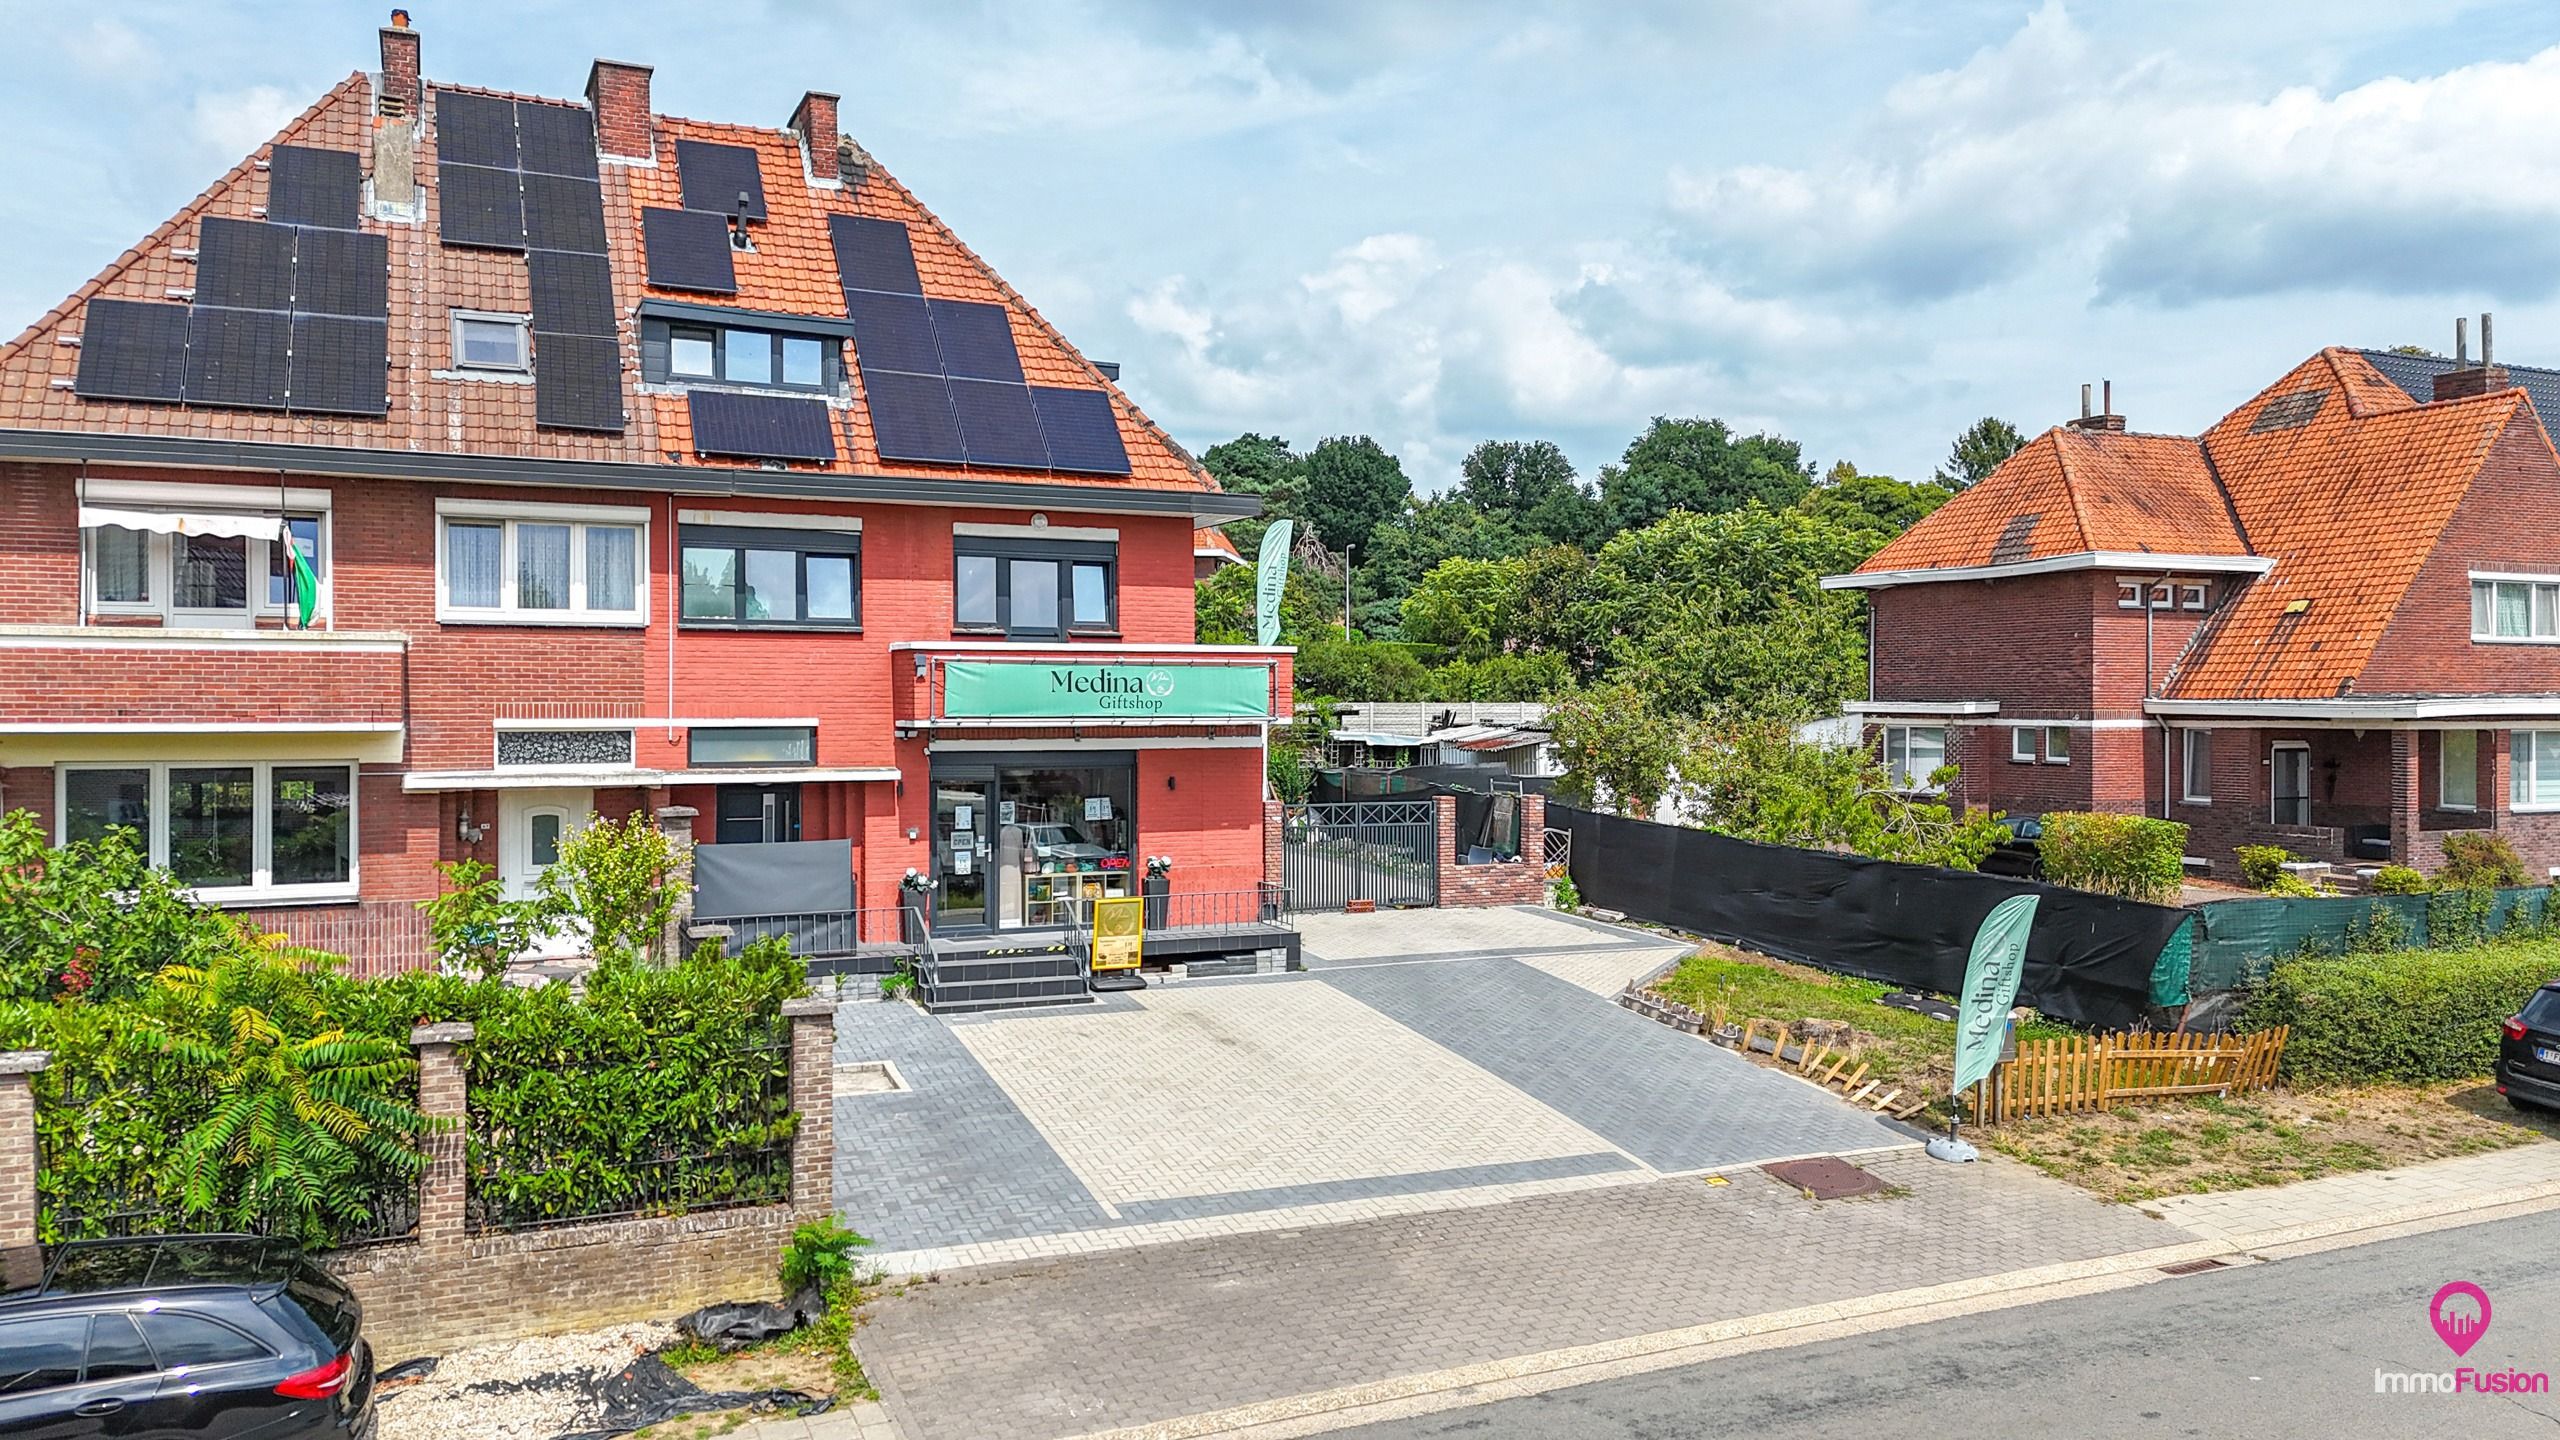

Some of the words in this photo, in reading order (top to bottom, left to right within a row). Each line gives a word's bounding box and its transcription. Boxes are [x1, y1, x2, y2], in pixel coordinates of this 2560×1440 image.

[1262, 566, 1278, 629] Medina
[1051, 669, 1143, 693] Medina
[1099, 695, 1163, 713] Giftshop
[1100, 858, 1131, 868] OPEN
[1996, 943, 2020, 1006] Giftshop
[1966, 961, 2001, 1052] Medina
